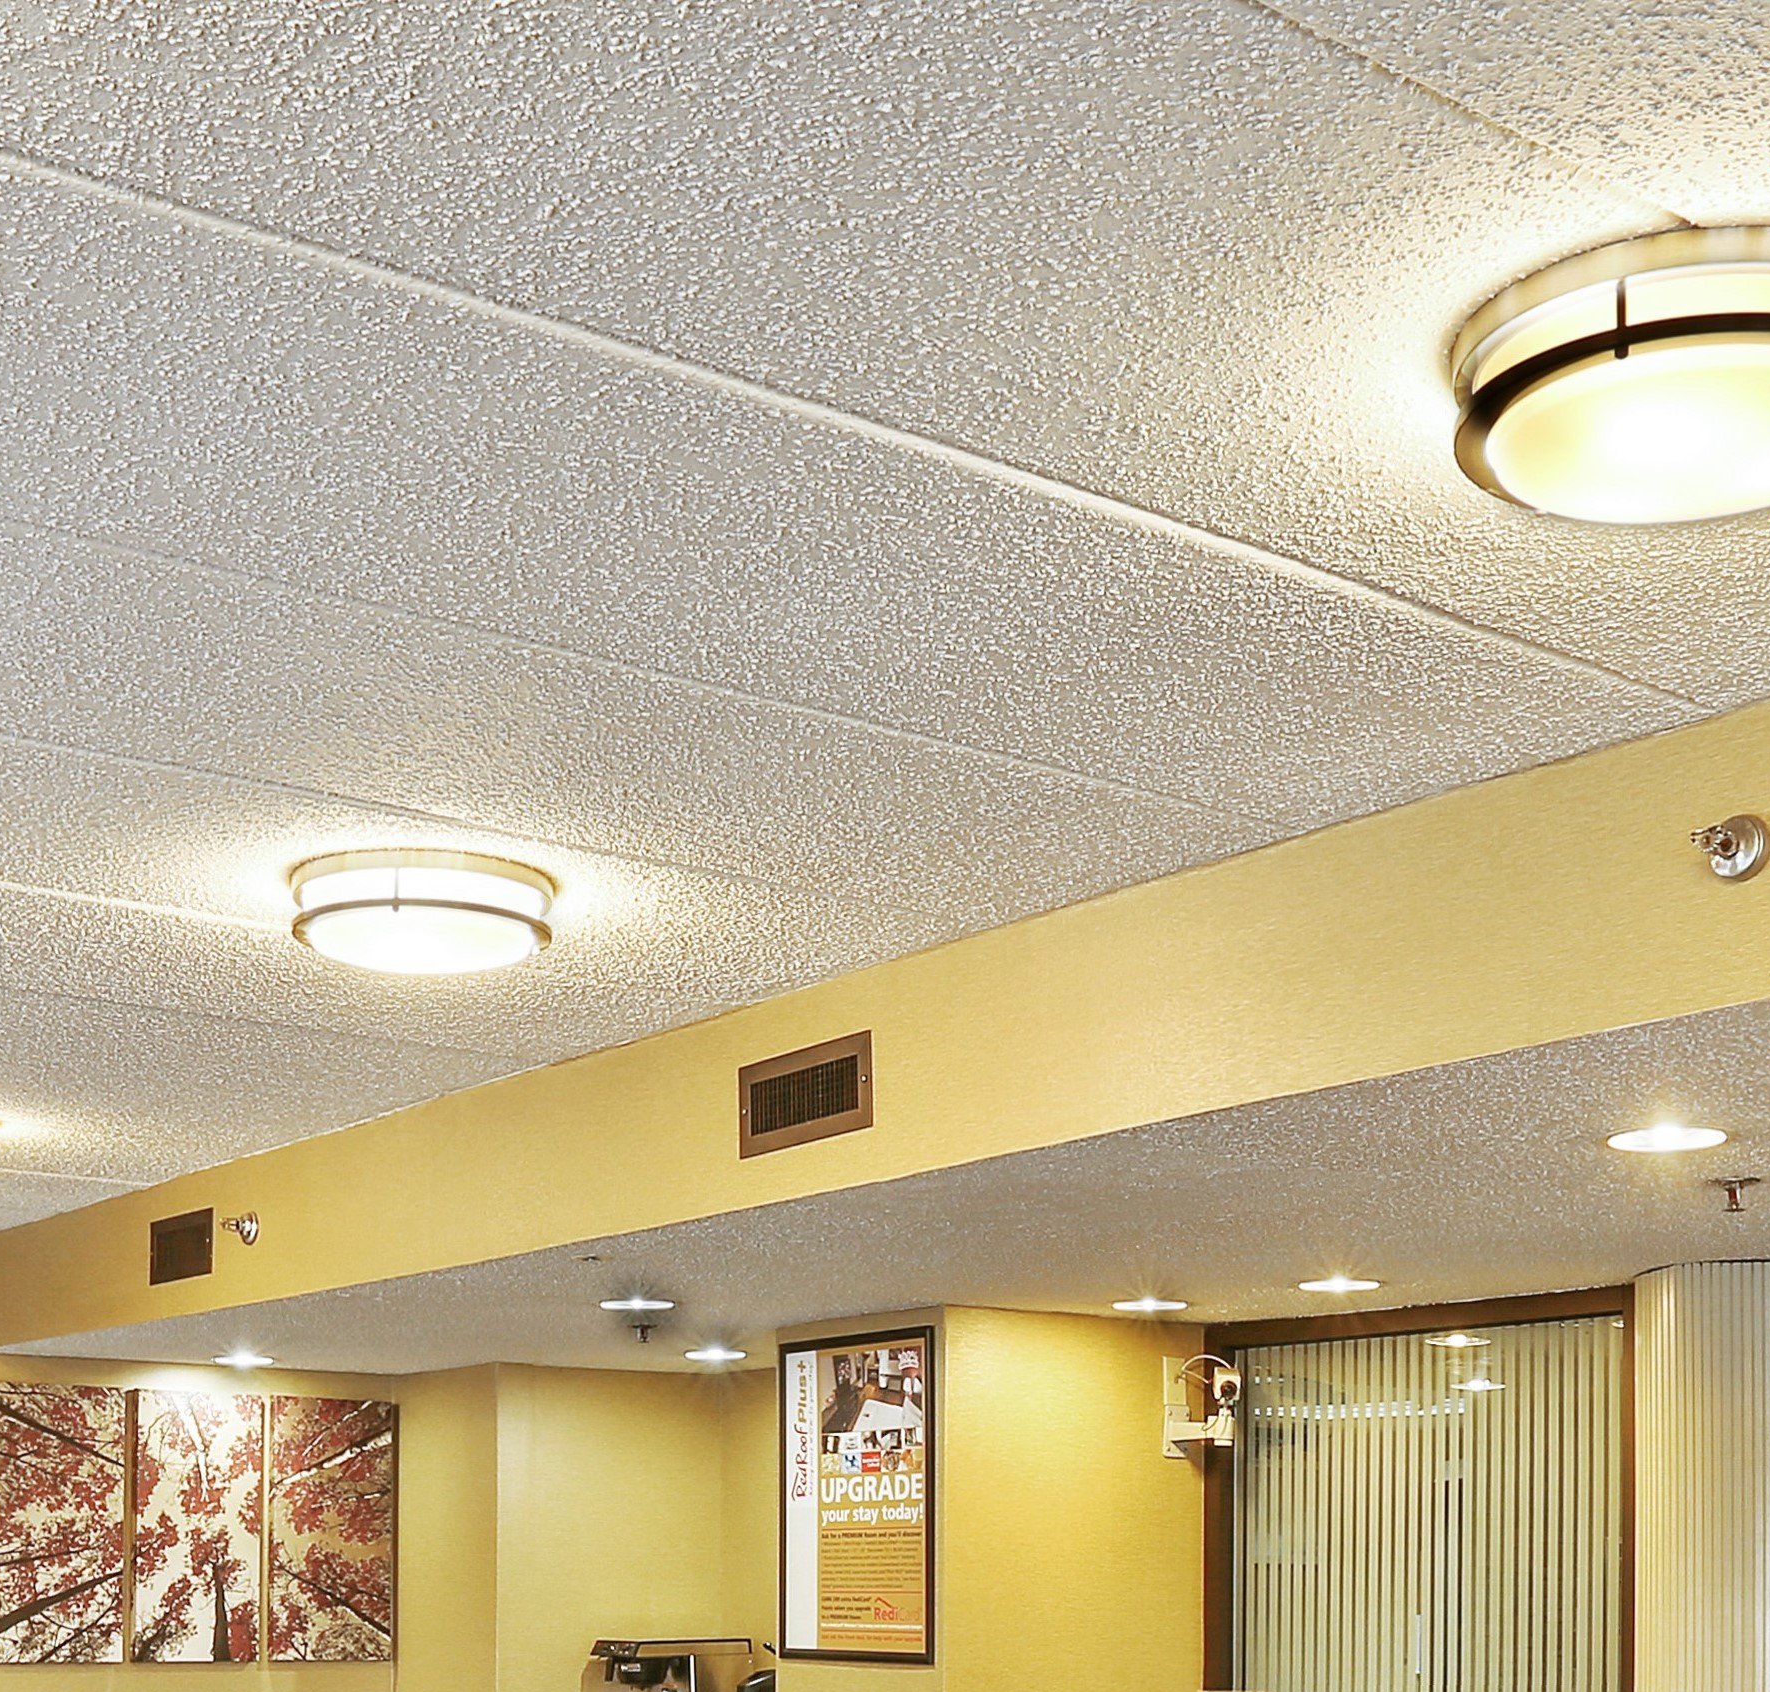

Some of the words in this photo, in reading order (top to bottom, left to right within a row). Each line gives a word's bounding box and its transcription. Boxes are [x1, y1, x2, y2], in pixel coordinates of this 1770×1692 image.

[820, 1473, 923, 1503] UPGRADE
[821, 1508, 850, 1527] your
[852, 1505, 879, 1526] stay
[881, 1502, 924, 1525] today!
